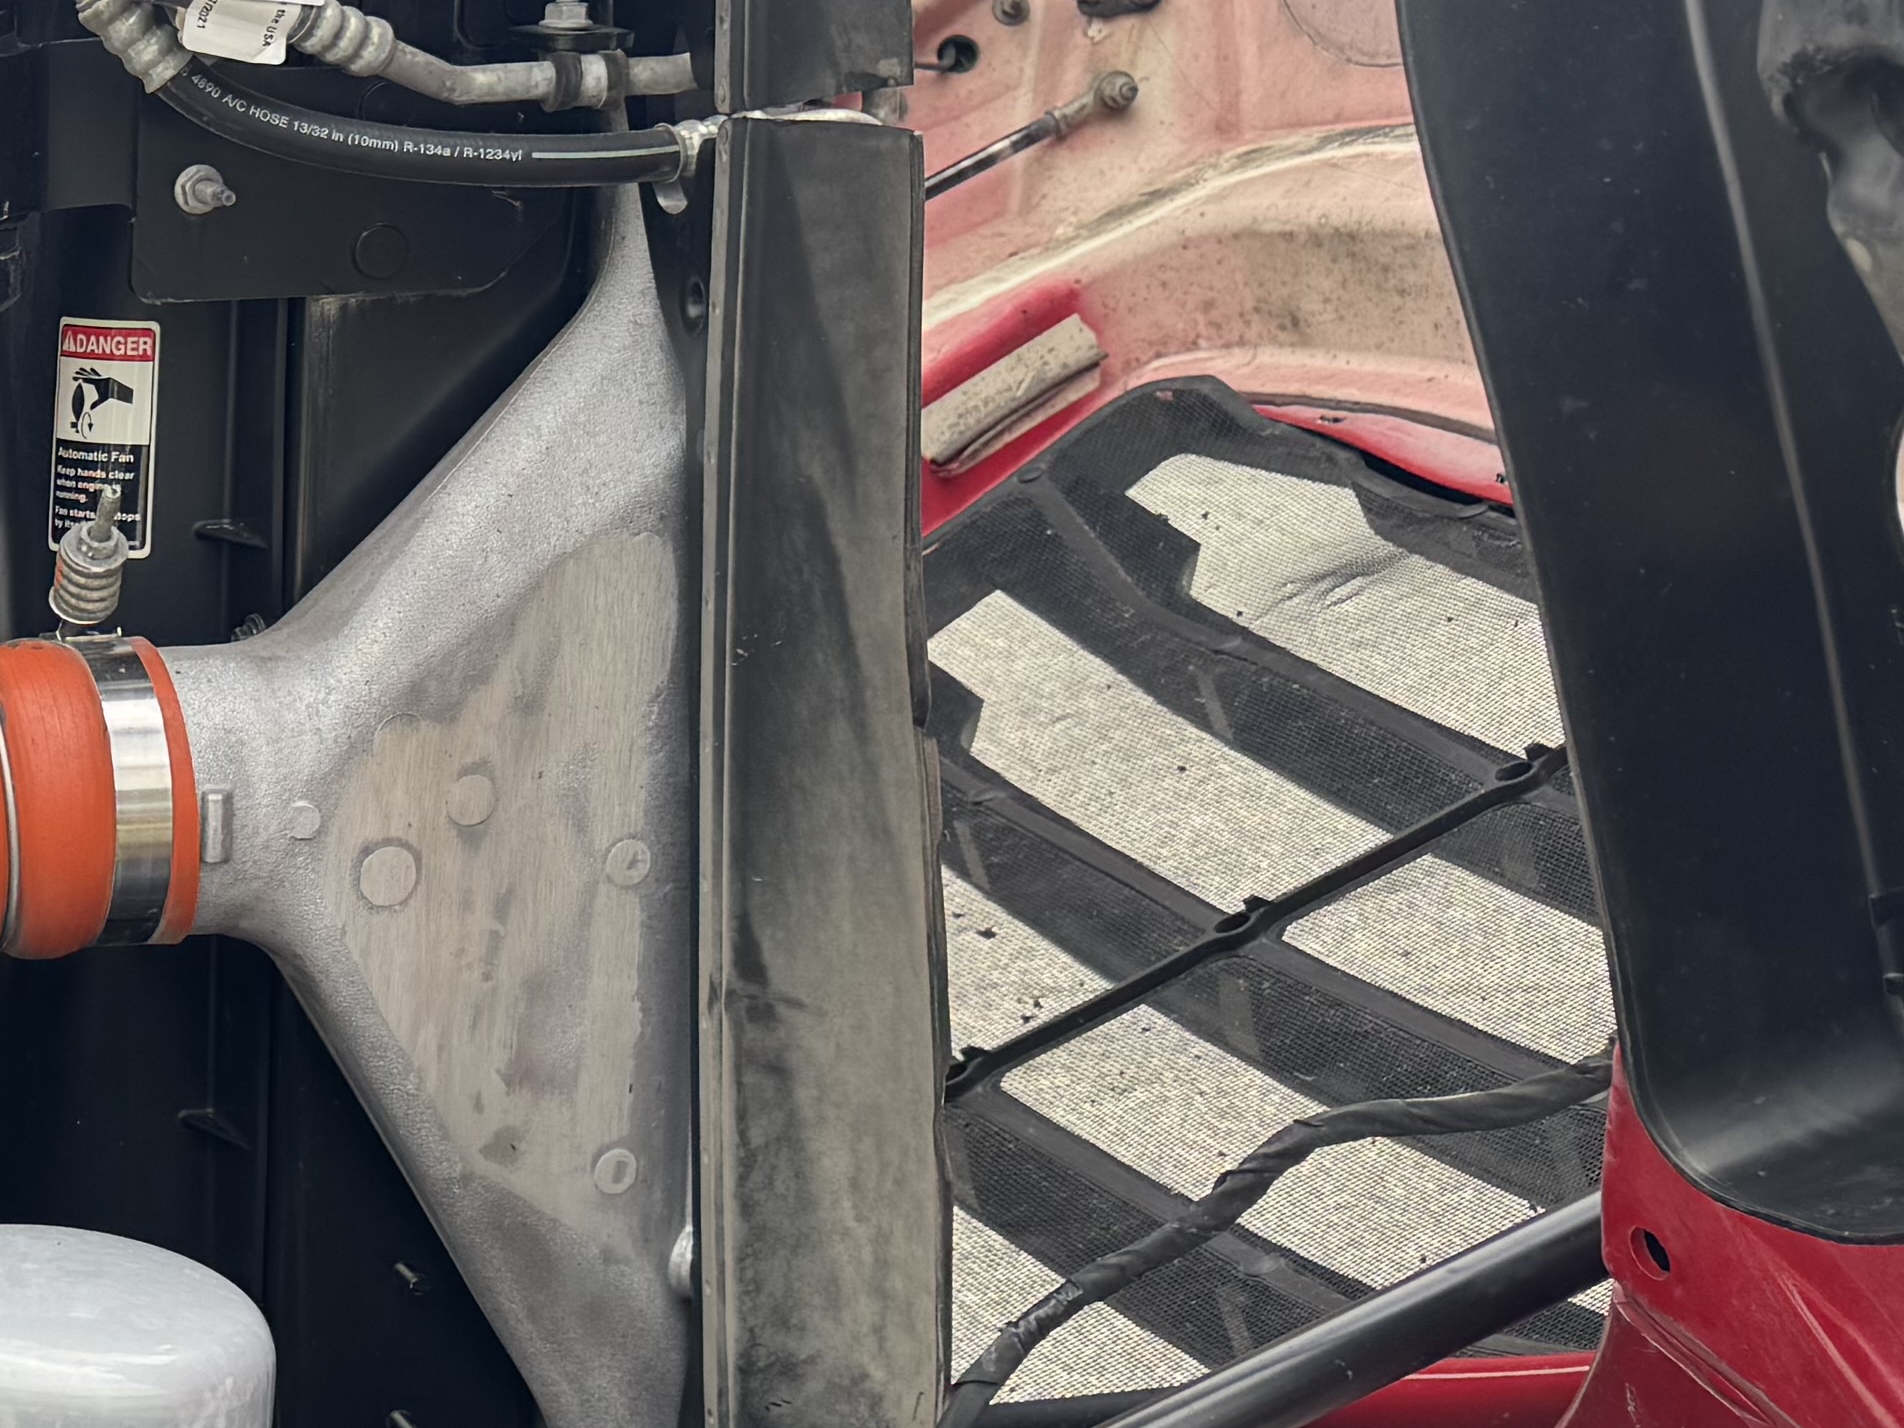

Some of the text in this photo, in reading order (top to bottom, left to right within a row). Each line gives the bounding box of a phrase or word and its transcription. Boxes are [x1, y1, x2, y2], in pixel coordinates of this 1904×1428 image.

[262, 26, 278, 48] USA
[191, 73, 221, 100] 4890
[222, 94, 247, 113] A/C
[249, 106, 290, 129] HOSE
[293, 119, 329, 140] 13/32
[348, 132, 399, 152] (10mm)
[403, 140, 452, 158] R-134a
[76, 335, 152, 356] DANGER
[58, 447, 134, 463] Automatic Fan
[77, 468, 107, 479] hands
[109, 470, 135, 480] clear
